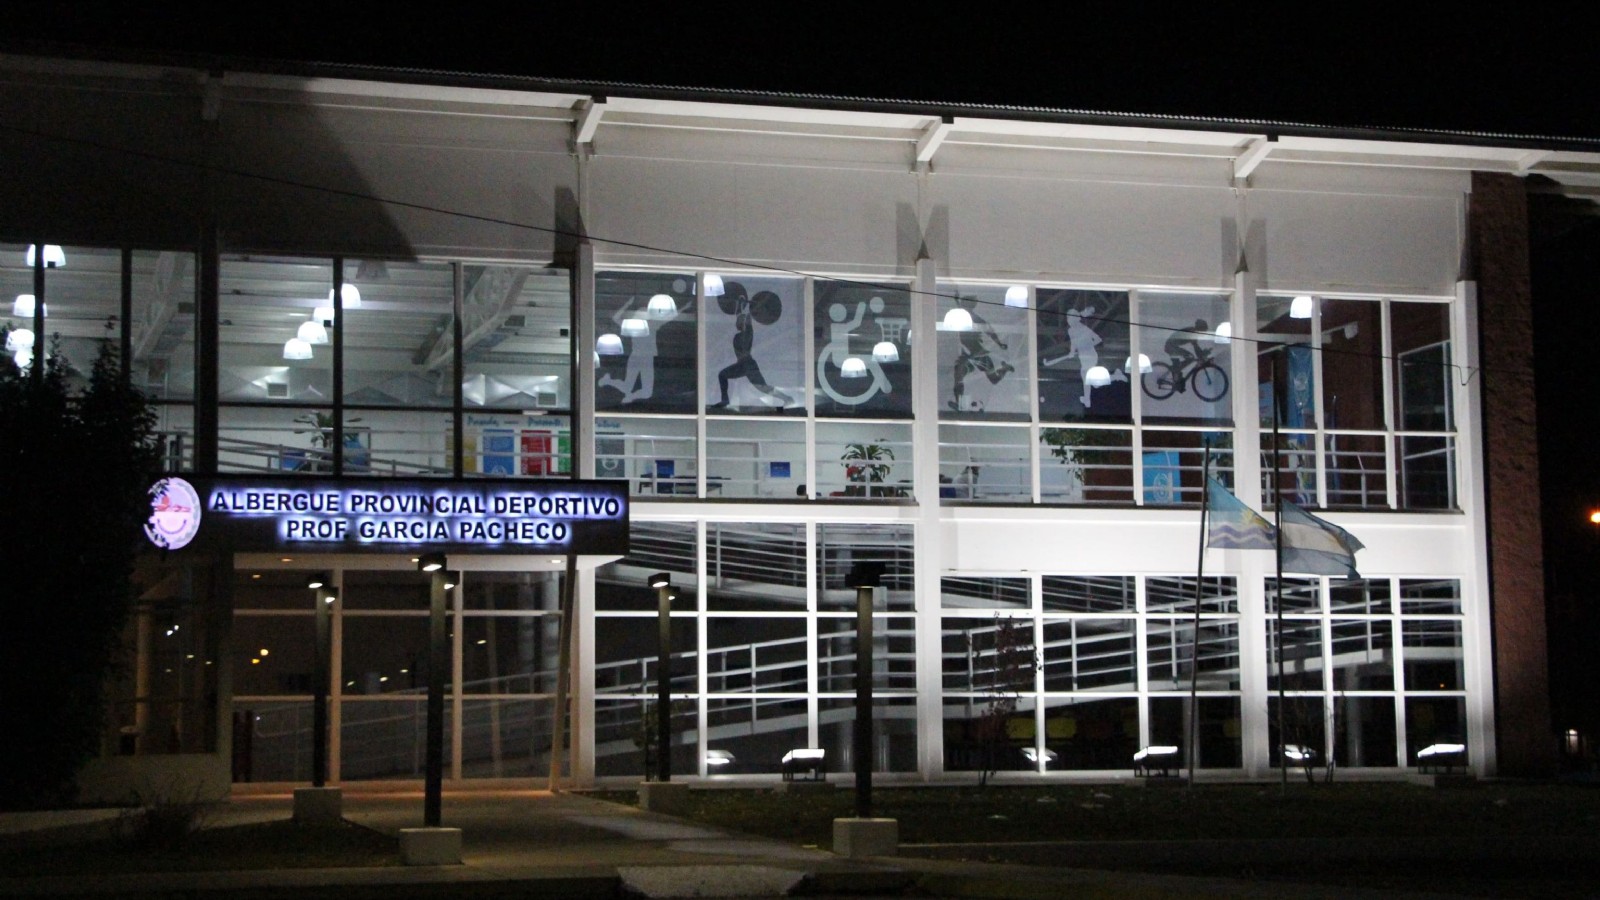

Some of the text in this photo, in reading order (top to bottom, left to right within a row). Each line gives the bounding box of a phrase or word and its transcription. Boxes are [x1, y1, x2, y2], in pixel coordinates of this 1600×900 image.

[213, 491, 620, 516] ALBERGUE PROVINCIAL DEPORTIVO
[286, 519, 567, 541] PROF. GARCIA PACHECO
